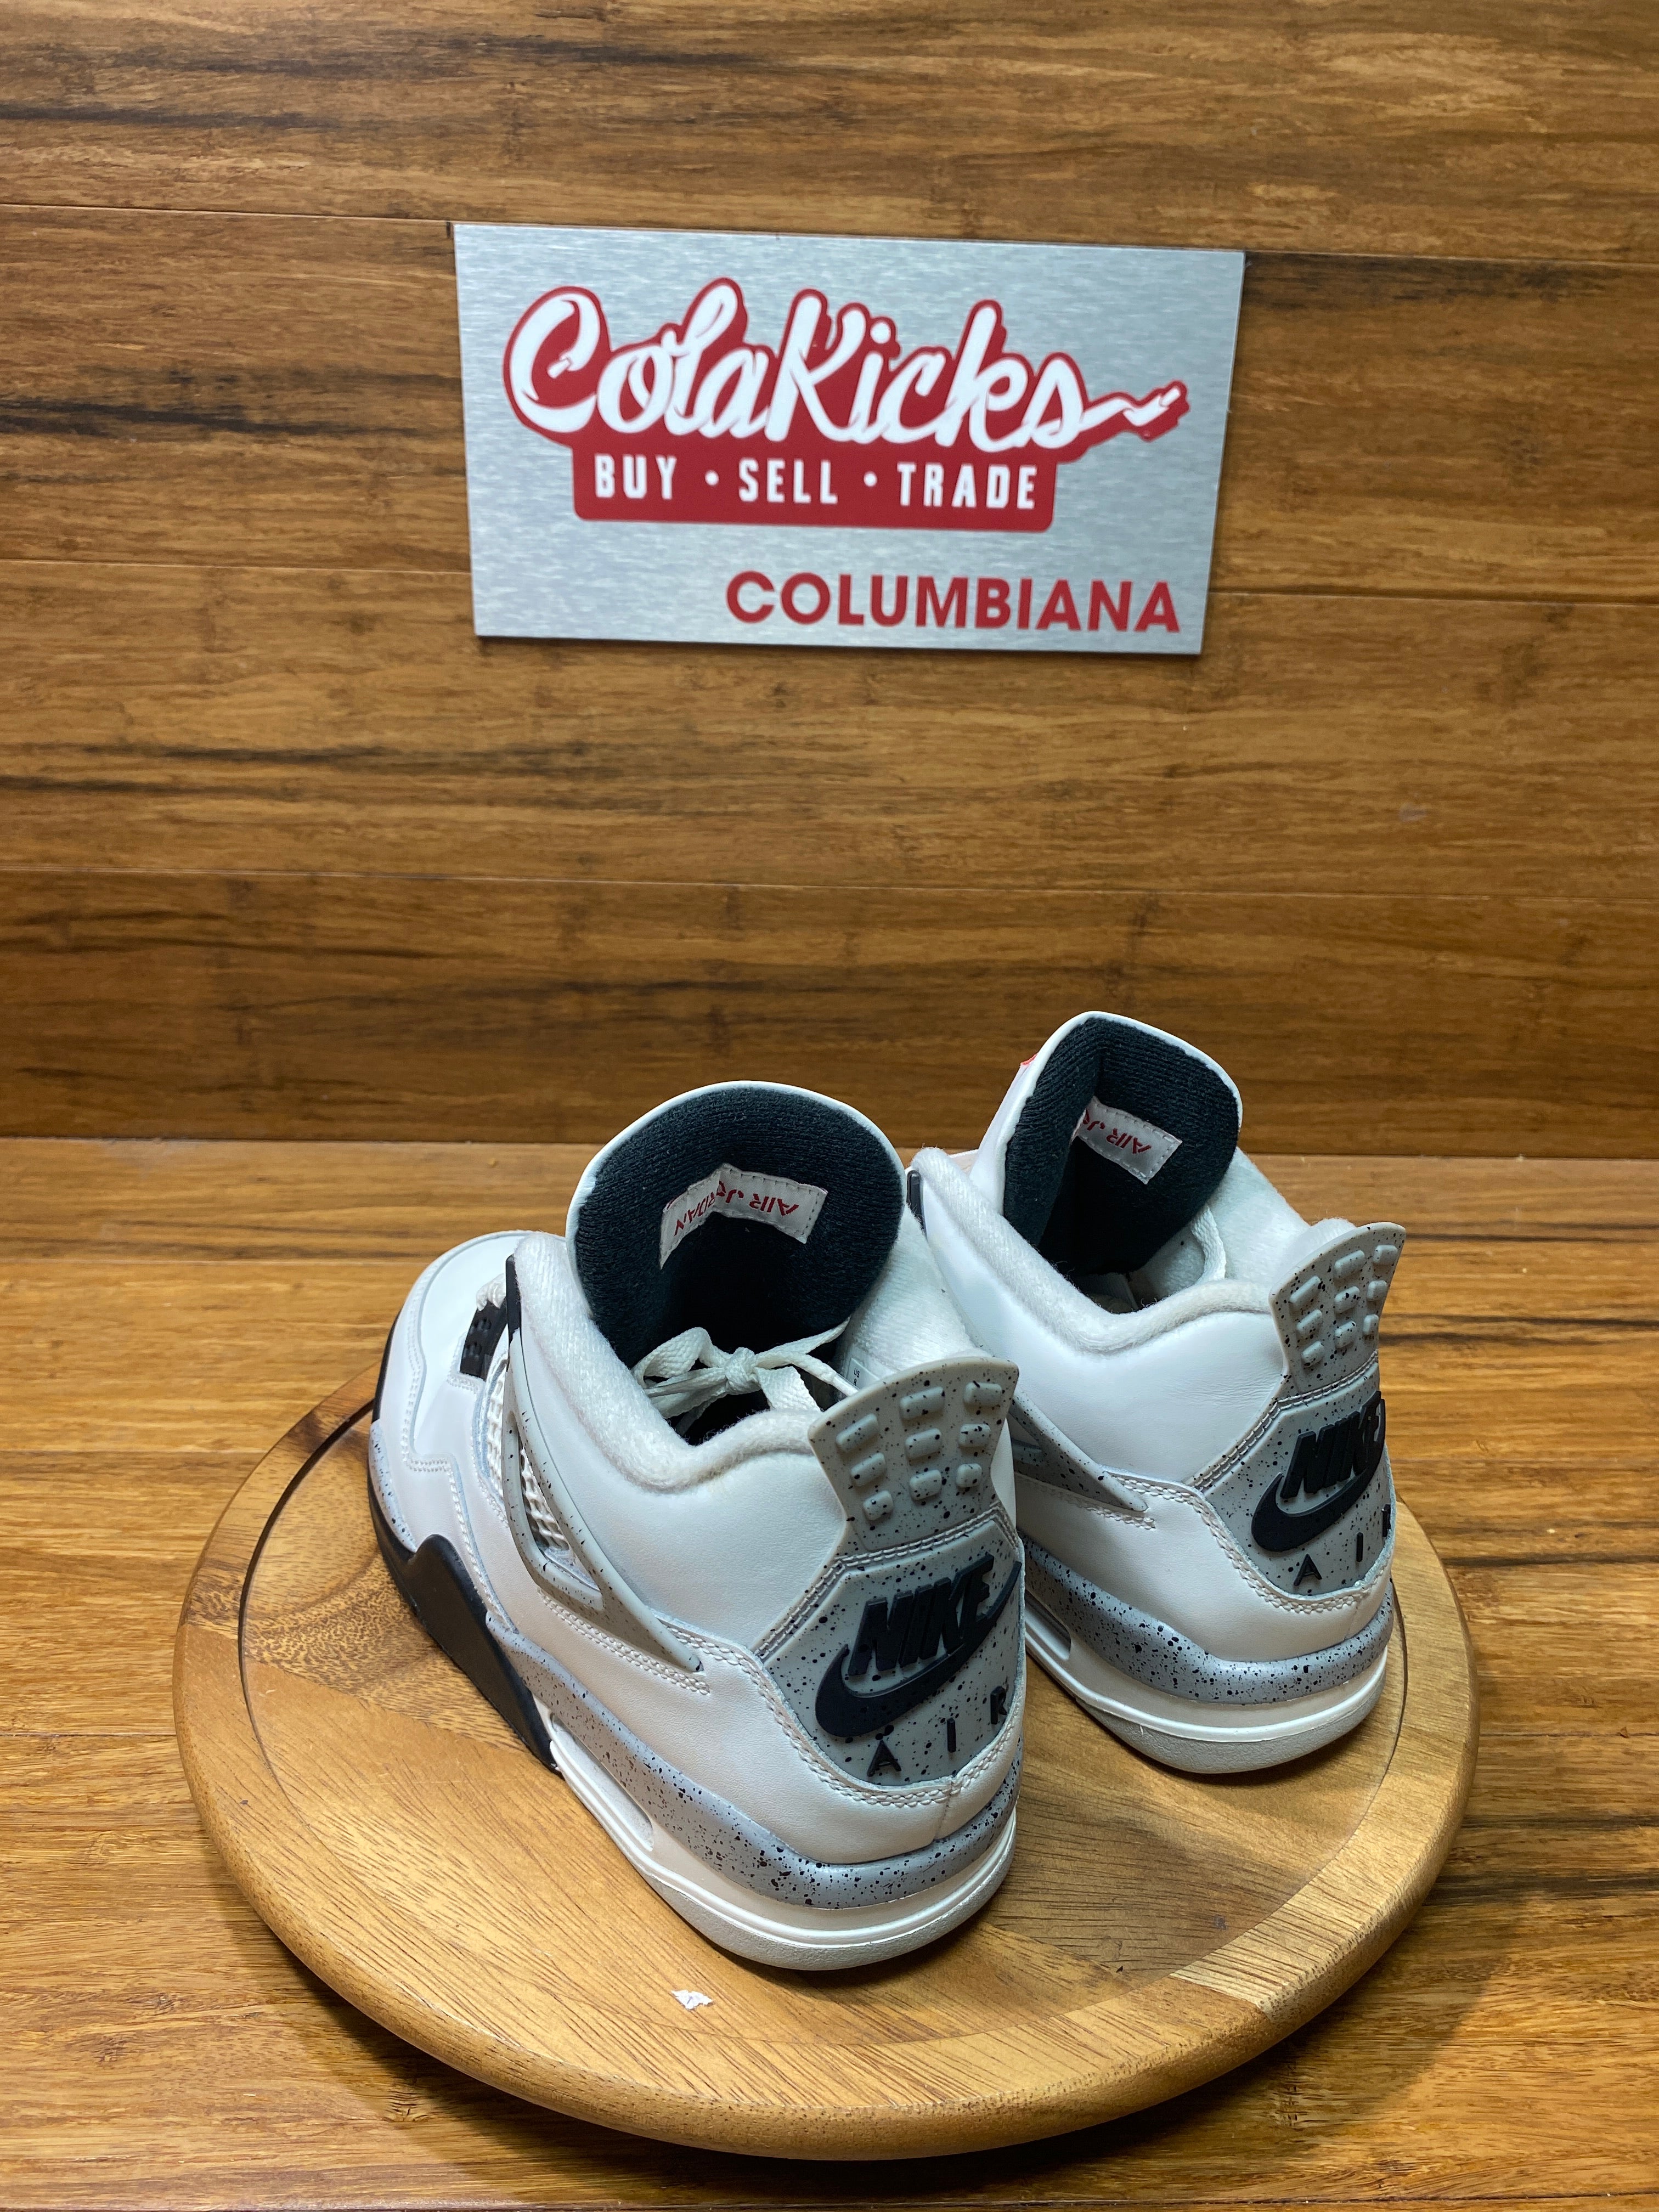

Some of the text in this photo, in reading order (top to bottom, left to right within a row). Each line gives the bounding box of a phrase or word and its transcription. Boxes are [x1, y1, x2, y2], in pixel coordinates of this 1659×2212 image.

[509, 281, 1181, 453] ColaKicks
[594, 453, 1038, 509] BUY SELL TRADE
[725, 570, 1181, 633] COLUMBIANA
[1105, 1128, 1152, 1154] AIR
[749, 1193, 799, 1216] AIR
[854, 1367, 860, 1378] US
[1279, 1390, 1382, 1499] NIKE
[848, 1552, 995, 1676] NIKE
[866, 1685, 1009, 1778] AIR
